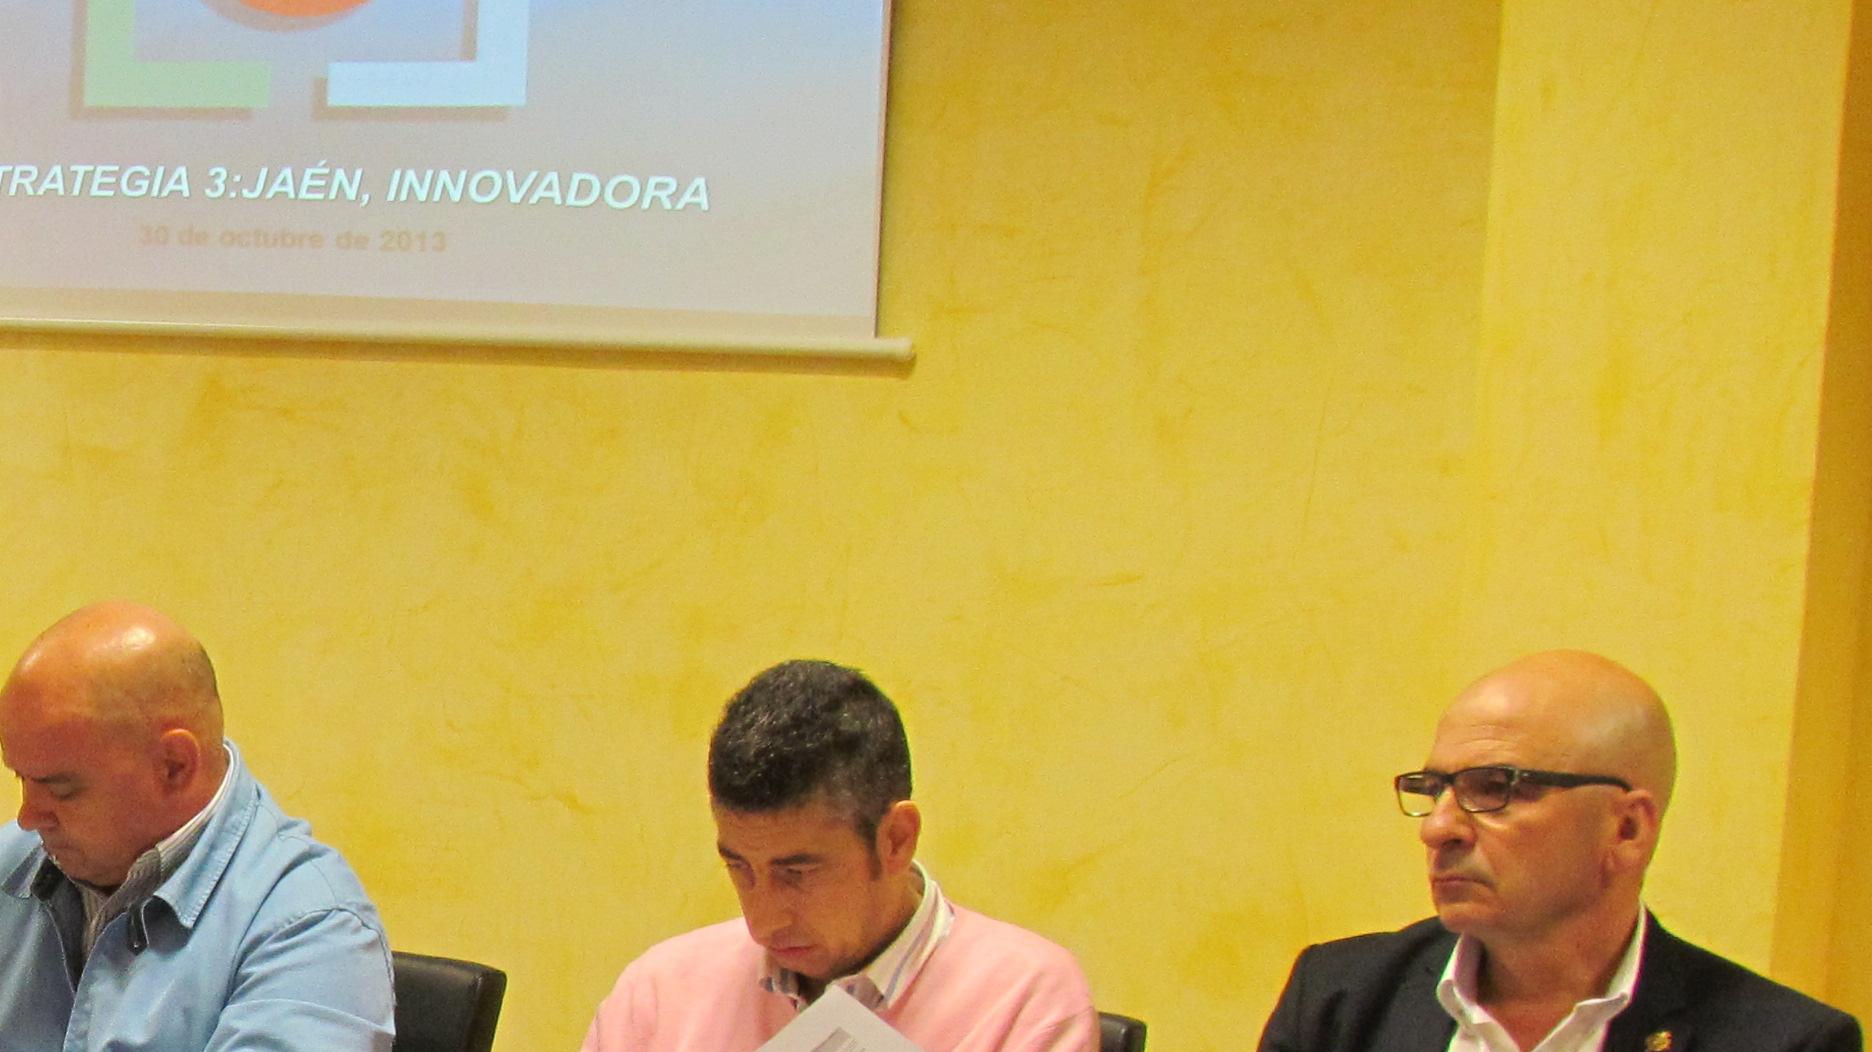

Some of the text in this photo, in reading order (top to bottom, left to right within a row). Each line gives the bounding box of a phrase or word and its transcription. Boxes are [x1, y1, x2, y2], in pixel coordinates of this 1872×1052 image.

[386, 168, 711, 212] INNOVADORA
[141, 224, 448, 252] 30 de octubre de 2013
